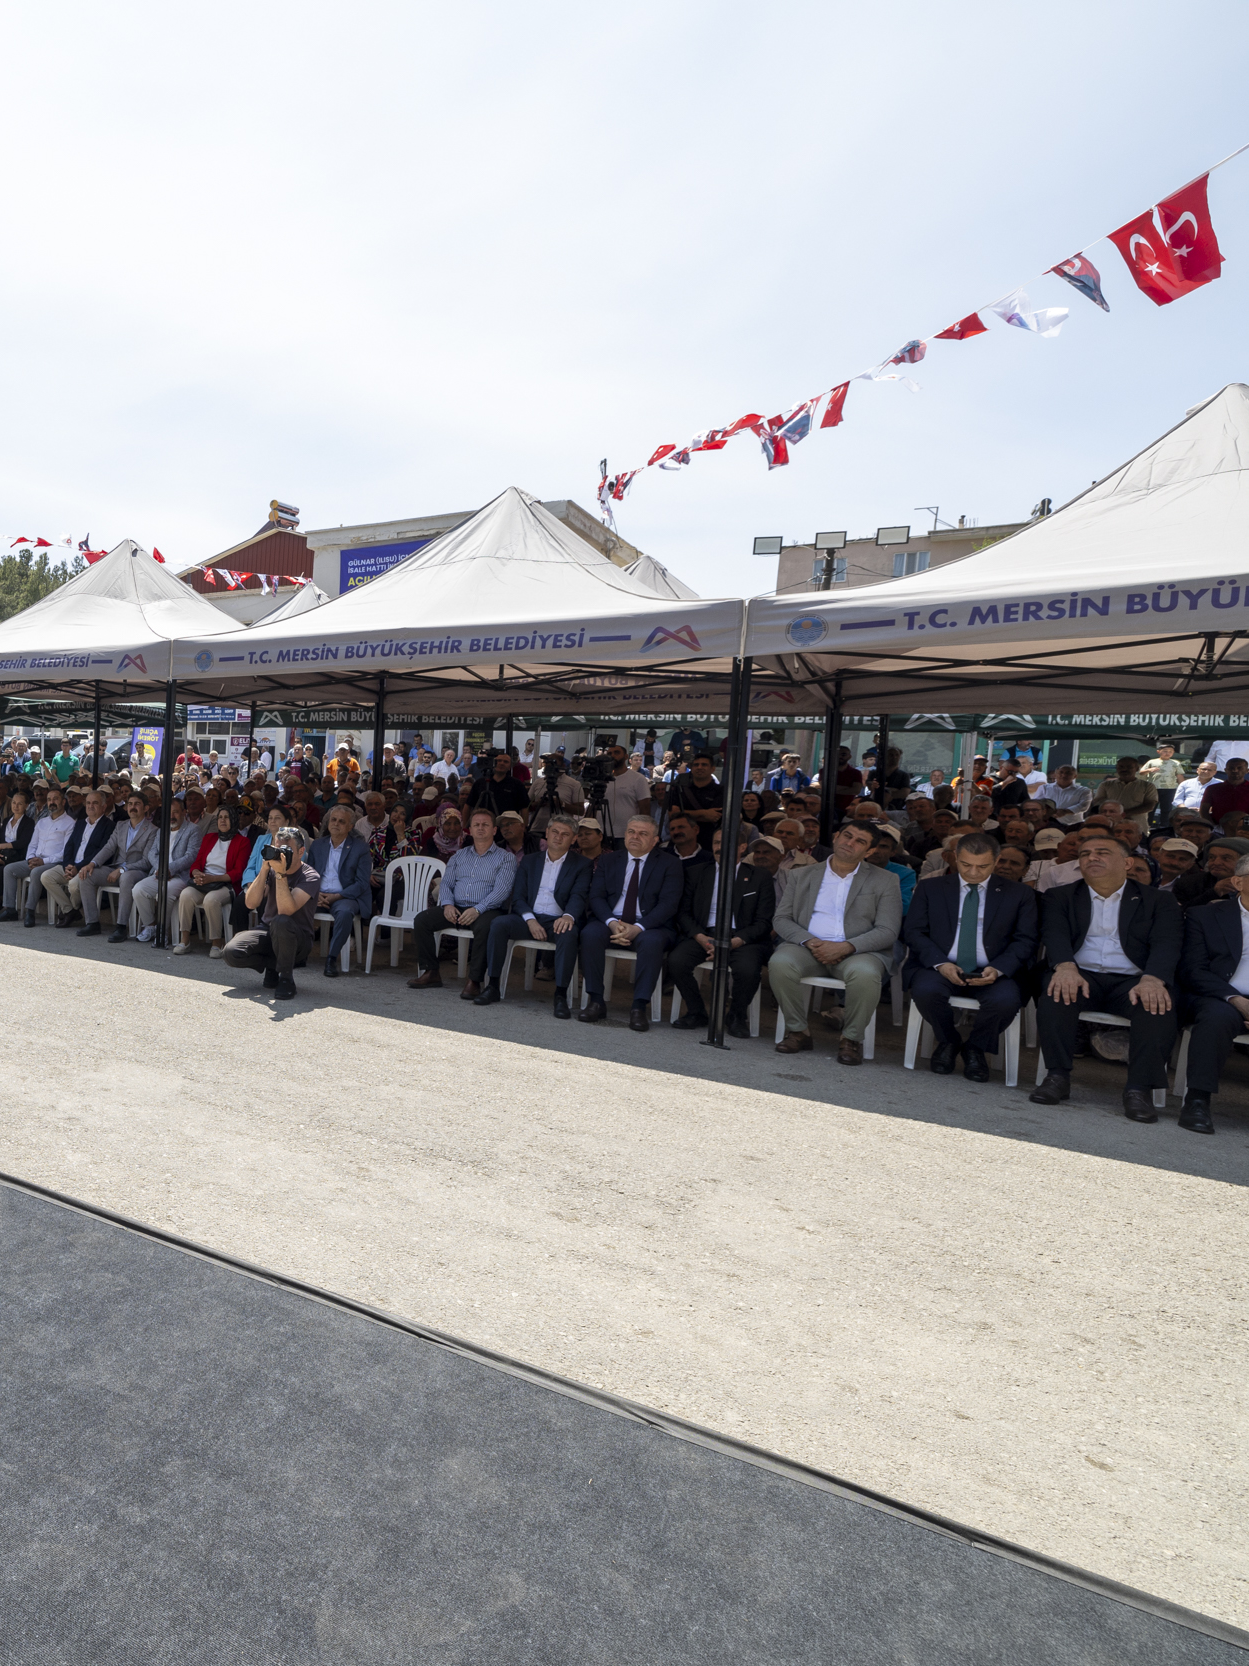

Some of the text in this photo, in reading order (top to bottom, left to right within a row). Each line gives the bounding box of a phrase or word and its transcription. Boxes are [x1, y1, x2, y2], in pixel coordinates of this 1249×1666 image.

[348, 553, 411, 567] GÜLNAR (ILISU) İÇ
[903, 608, 958, 631] T.C.
[967, 592, 1111, 626] MERSİN
[248, 627, 585, 665] T.C. MERSİN BÜYÜKŞEHİR BELEDİYESİ
[29, 653, 91, 668] BELEDİYESİ
[291, 712, 307, 722] T.C.
[309, 708, 348, 722] MERSİN
